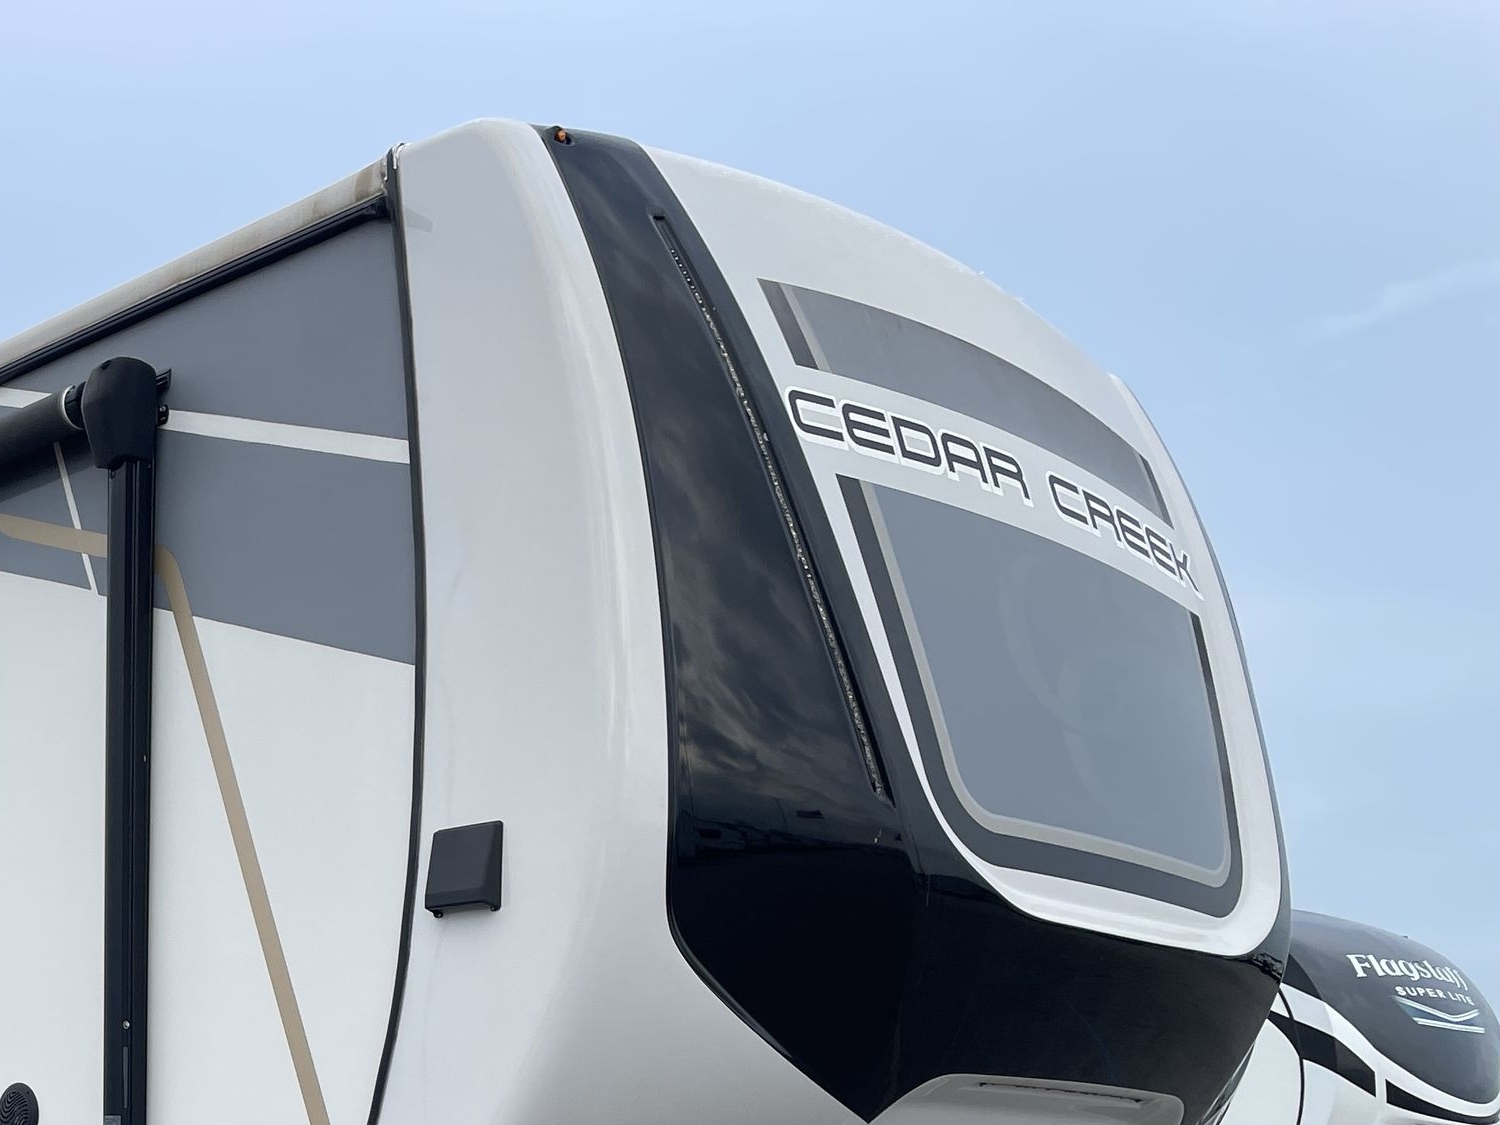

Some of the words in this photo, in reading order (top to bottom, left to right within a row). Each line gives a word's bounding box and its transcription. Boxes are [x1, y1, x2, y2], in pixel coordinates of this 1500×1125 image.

[786, 388, 1033, 504] CEDAR
[1047, 472, 1202, 597] CREEK
[1345, 954, 1469, 991] Flagstaff
[1394, 985, 1446, 999] SUPER
[1447, 990, 1476, 1006] LITE
